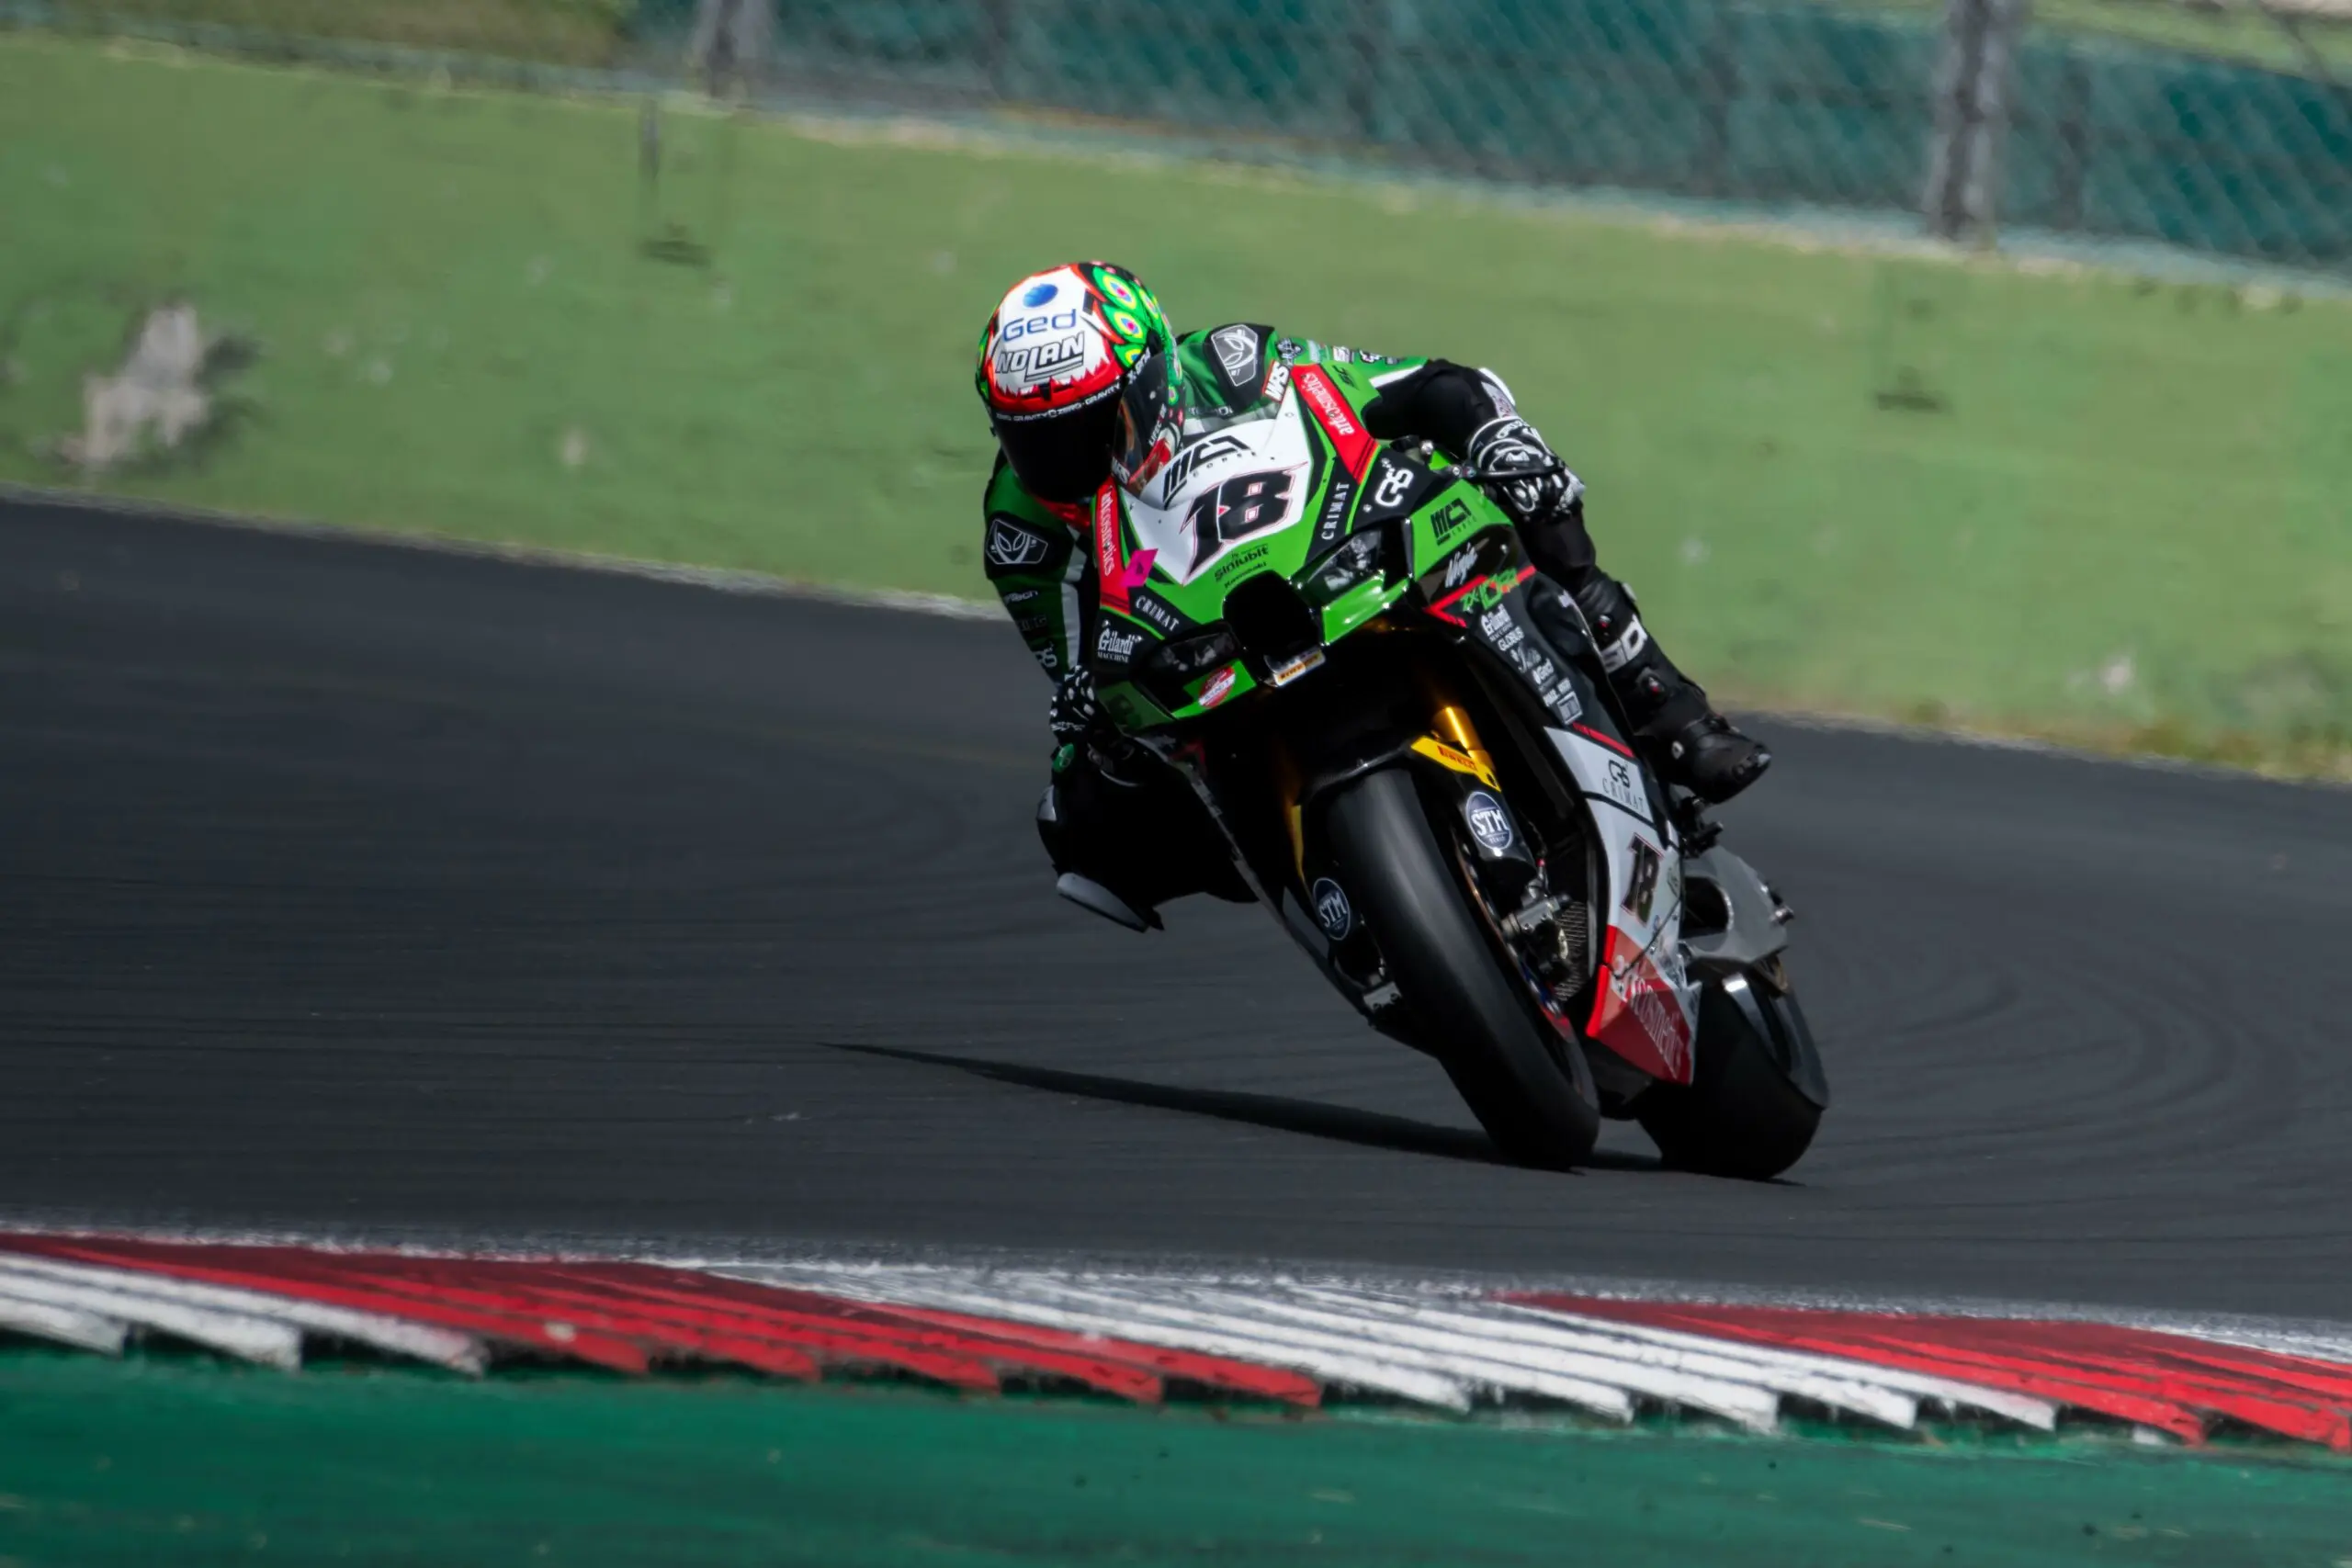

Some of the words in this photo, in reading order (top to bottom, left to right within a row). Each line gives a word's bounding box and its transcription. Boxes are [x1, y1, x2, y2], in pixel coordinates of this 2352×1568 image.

[1002, 308, 1077, 342] Ged
[995, 332, 1085, 382] NOLAN
[1264, 361, 1290, 401] WRS
[1180, 468, 1295, 579] 18
[1321, 482, 1350, 540] CRIMAT
[1136, 596, 1180, 632] CRIMAT
[1098, 627, 1136, 656] Gilardi
[1601, 778, 1645, 812] CRIMAT
[1470, 807, 1509, 838] STM
[1317, 892, 1348, 930] STM
